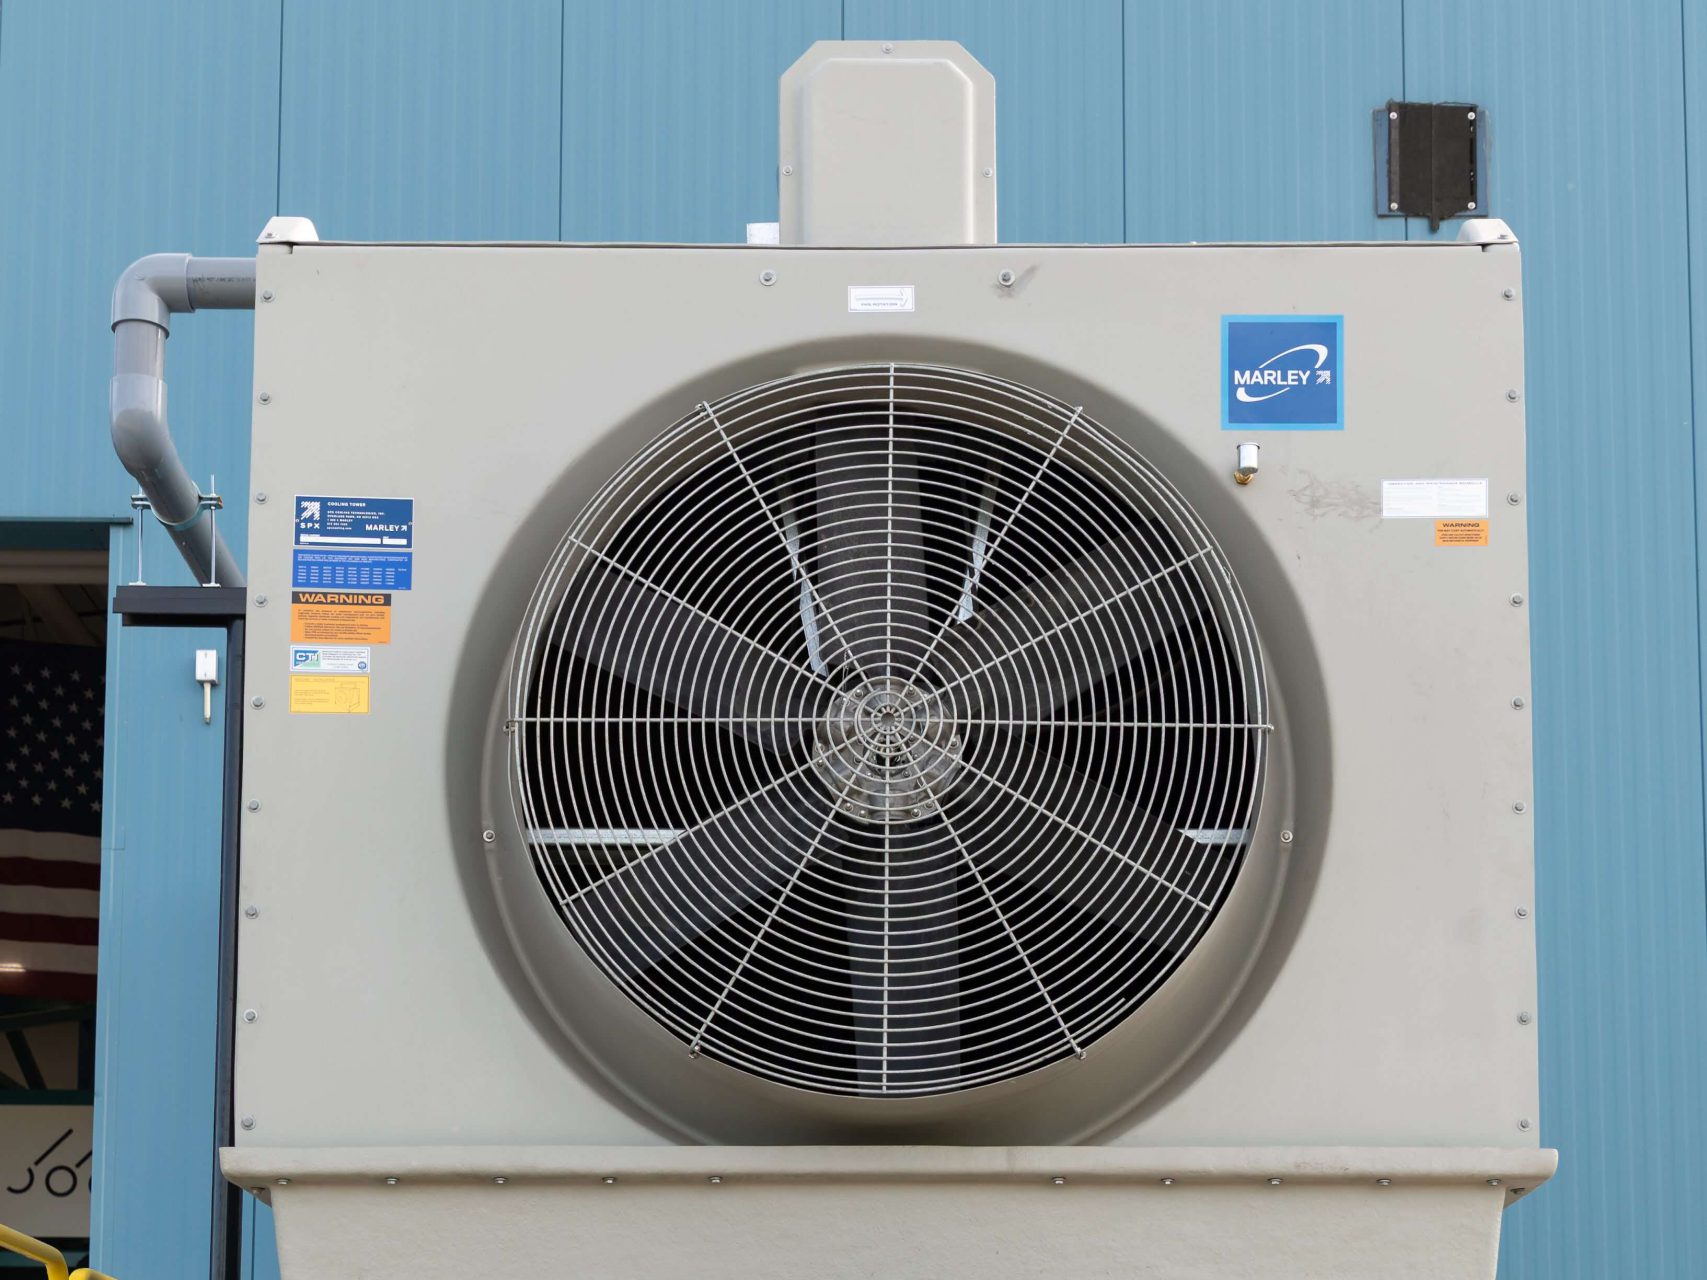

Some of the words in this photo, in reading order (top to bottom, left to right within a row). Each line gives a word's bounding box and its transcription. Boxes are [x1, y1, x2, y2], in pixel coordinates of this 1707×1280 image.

[1234, 370, 1311, 385] MARLEY
[299, 593, 385, 604] WARNING
[296, 652, 319, 661] CTI
